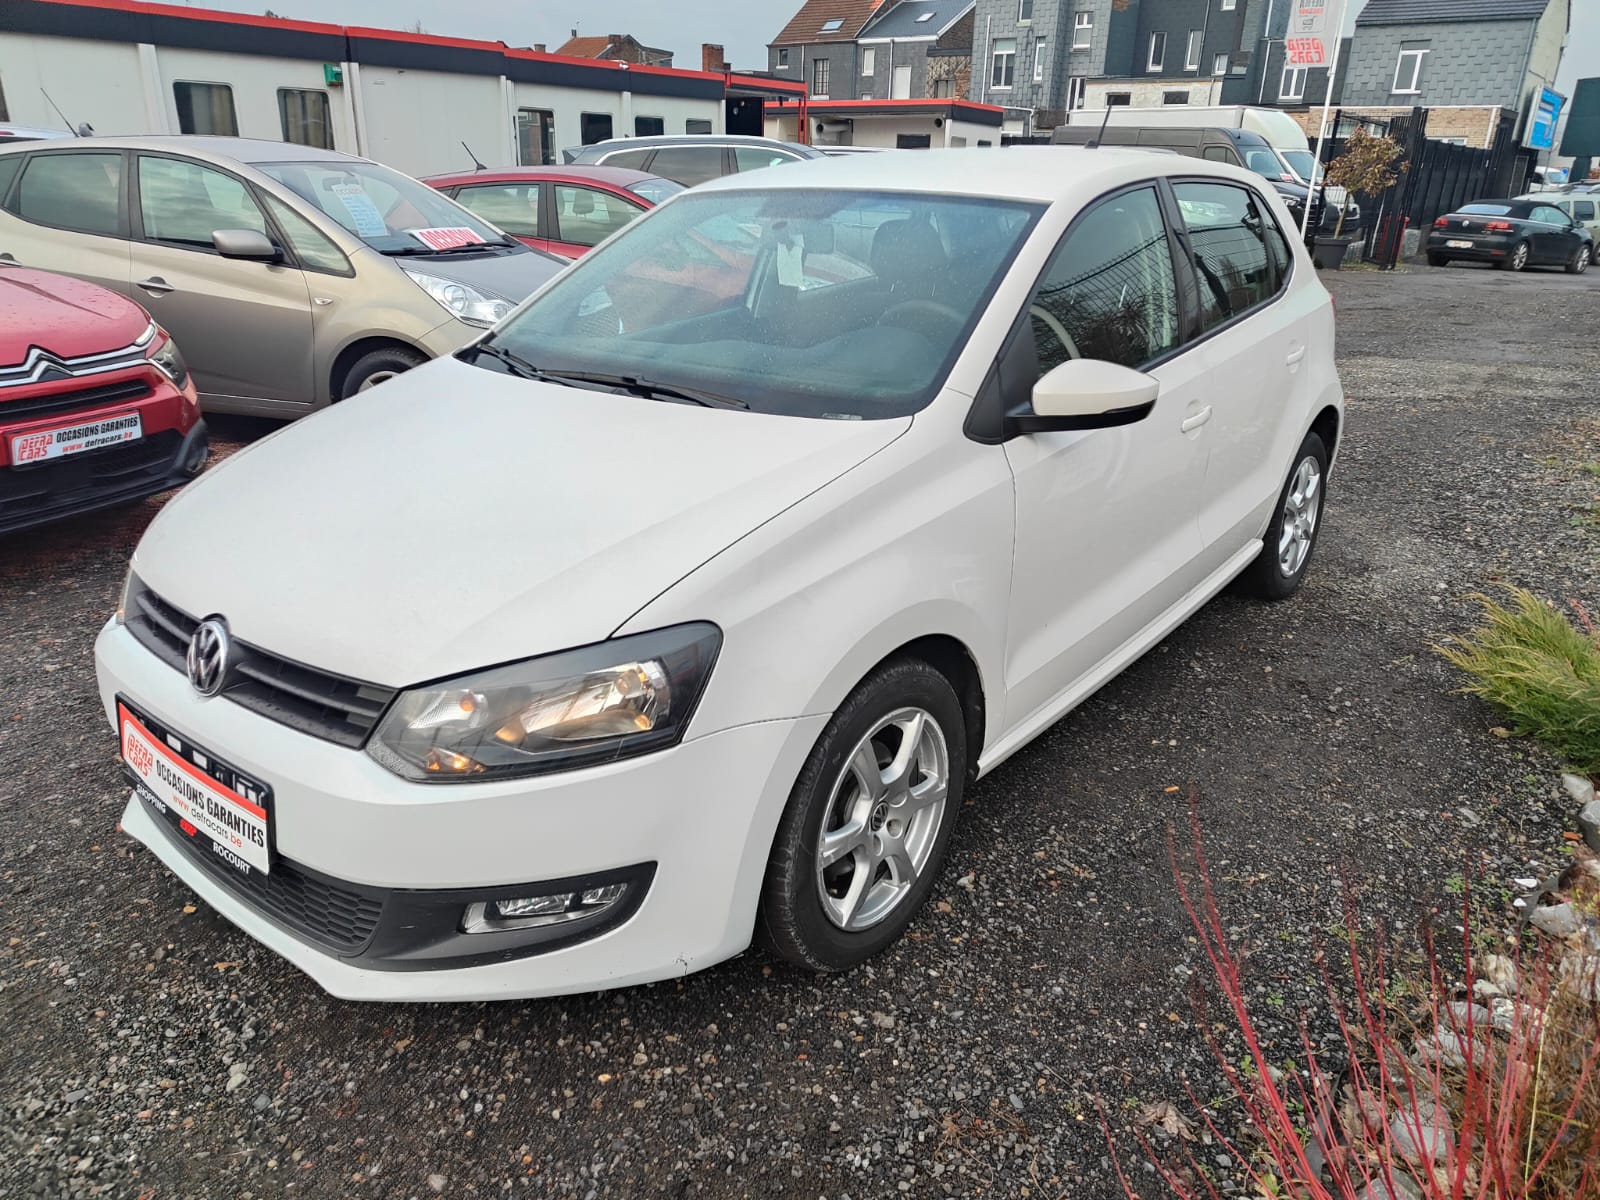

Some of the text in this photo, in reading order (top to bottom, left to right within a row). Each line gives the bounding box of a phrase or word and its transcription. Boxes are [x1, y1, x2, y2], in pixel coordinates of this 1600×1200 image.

[20, 434, 53, 450] DEFRA
[56, 416, 138, 443] OCCASIONS GARANTIES
[62, 431, 134, 453] www.defracars.be
[18, 446, 48, 462] CARS
[127, 747, 151, 777] CARS
[128, 733, 154, 768] DEFRA
[136, 784, 167, 814] SHOPPING
[156, 760, 265, 848] OCCASIONS GARANTIES
[212, 842, 251, 875] ROCOURT
